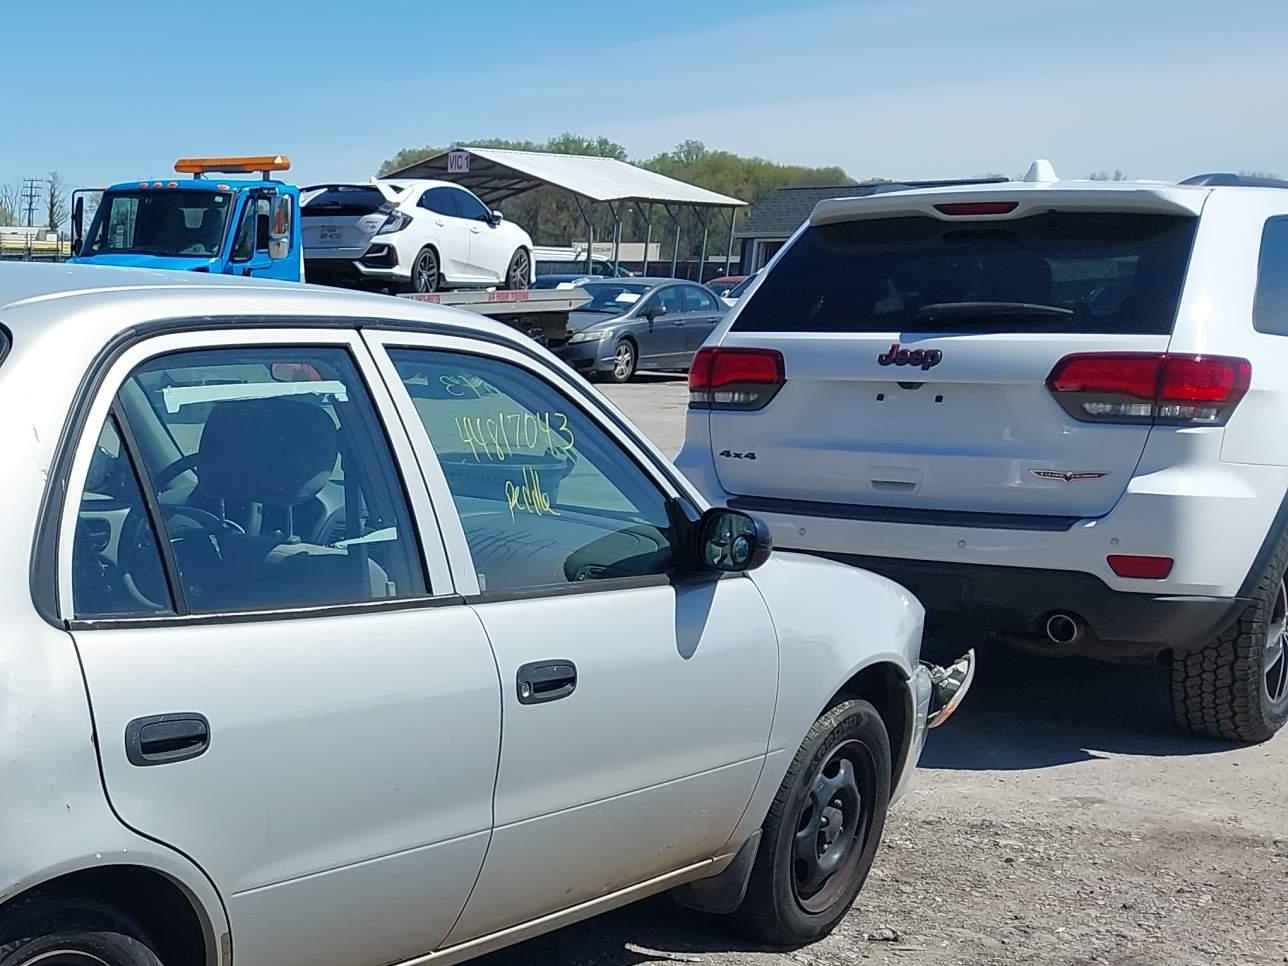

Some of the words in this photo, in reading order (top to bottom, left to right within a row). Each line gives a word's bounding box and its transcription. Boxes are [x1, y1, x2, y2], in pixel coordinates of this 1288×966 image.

[449, 154, 463, 170] VIC
[464, 154, 469, 169] 1
[877, 343, 943, 371] Jeep
[455, 411, 575, 463] 44817043
[718, 449, 757, 461] 4x4
